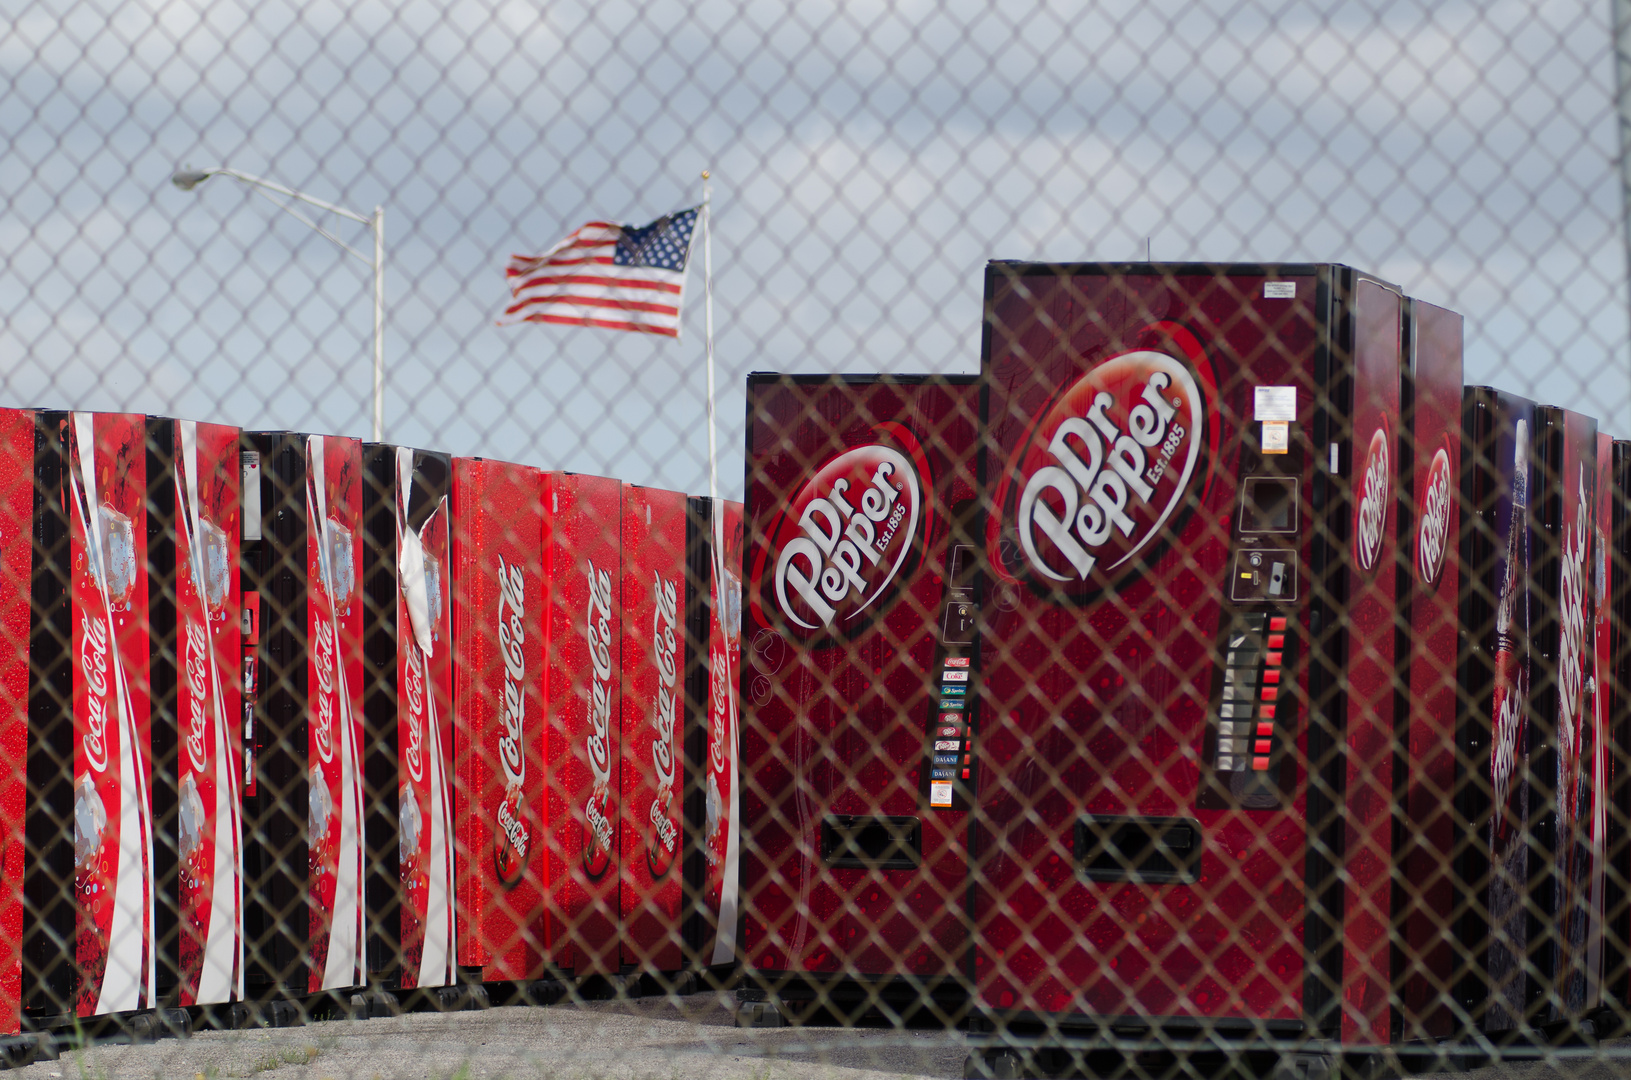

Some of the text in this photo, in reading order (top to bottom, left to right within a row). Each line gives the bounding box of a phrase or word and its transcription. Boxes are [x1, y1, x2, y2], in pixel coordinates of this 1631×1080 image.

[797, 478, 856, 558] Dr
[1018, 371, 1176, 582] Pepper
[1047, 391, 1120, 493] Dr
[775, 462, 899, 629] Pepper
[81, 607, 107, 773] Coca-Cola
[186, 614, 207, 773] Coca-Cola
[314, 611, 333, 763] Coca-Cola
[405, 635, 422, 782] Coca-Cola
[498, 553, 525, 786] Coca-Cola
[586, 558, 611, 784] Coca-Cola
[653, 569, 677, 786] Coca-Cola
[711, 645, 726, 773] Coca-Cola
[498, 801, 529, 858] Coca-Cola
[586, 797, 613, 851] Coca-Cola
[650, 800, 677, 853] Coca-Cola
